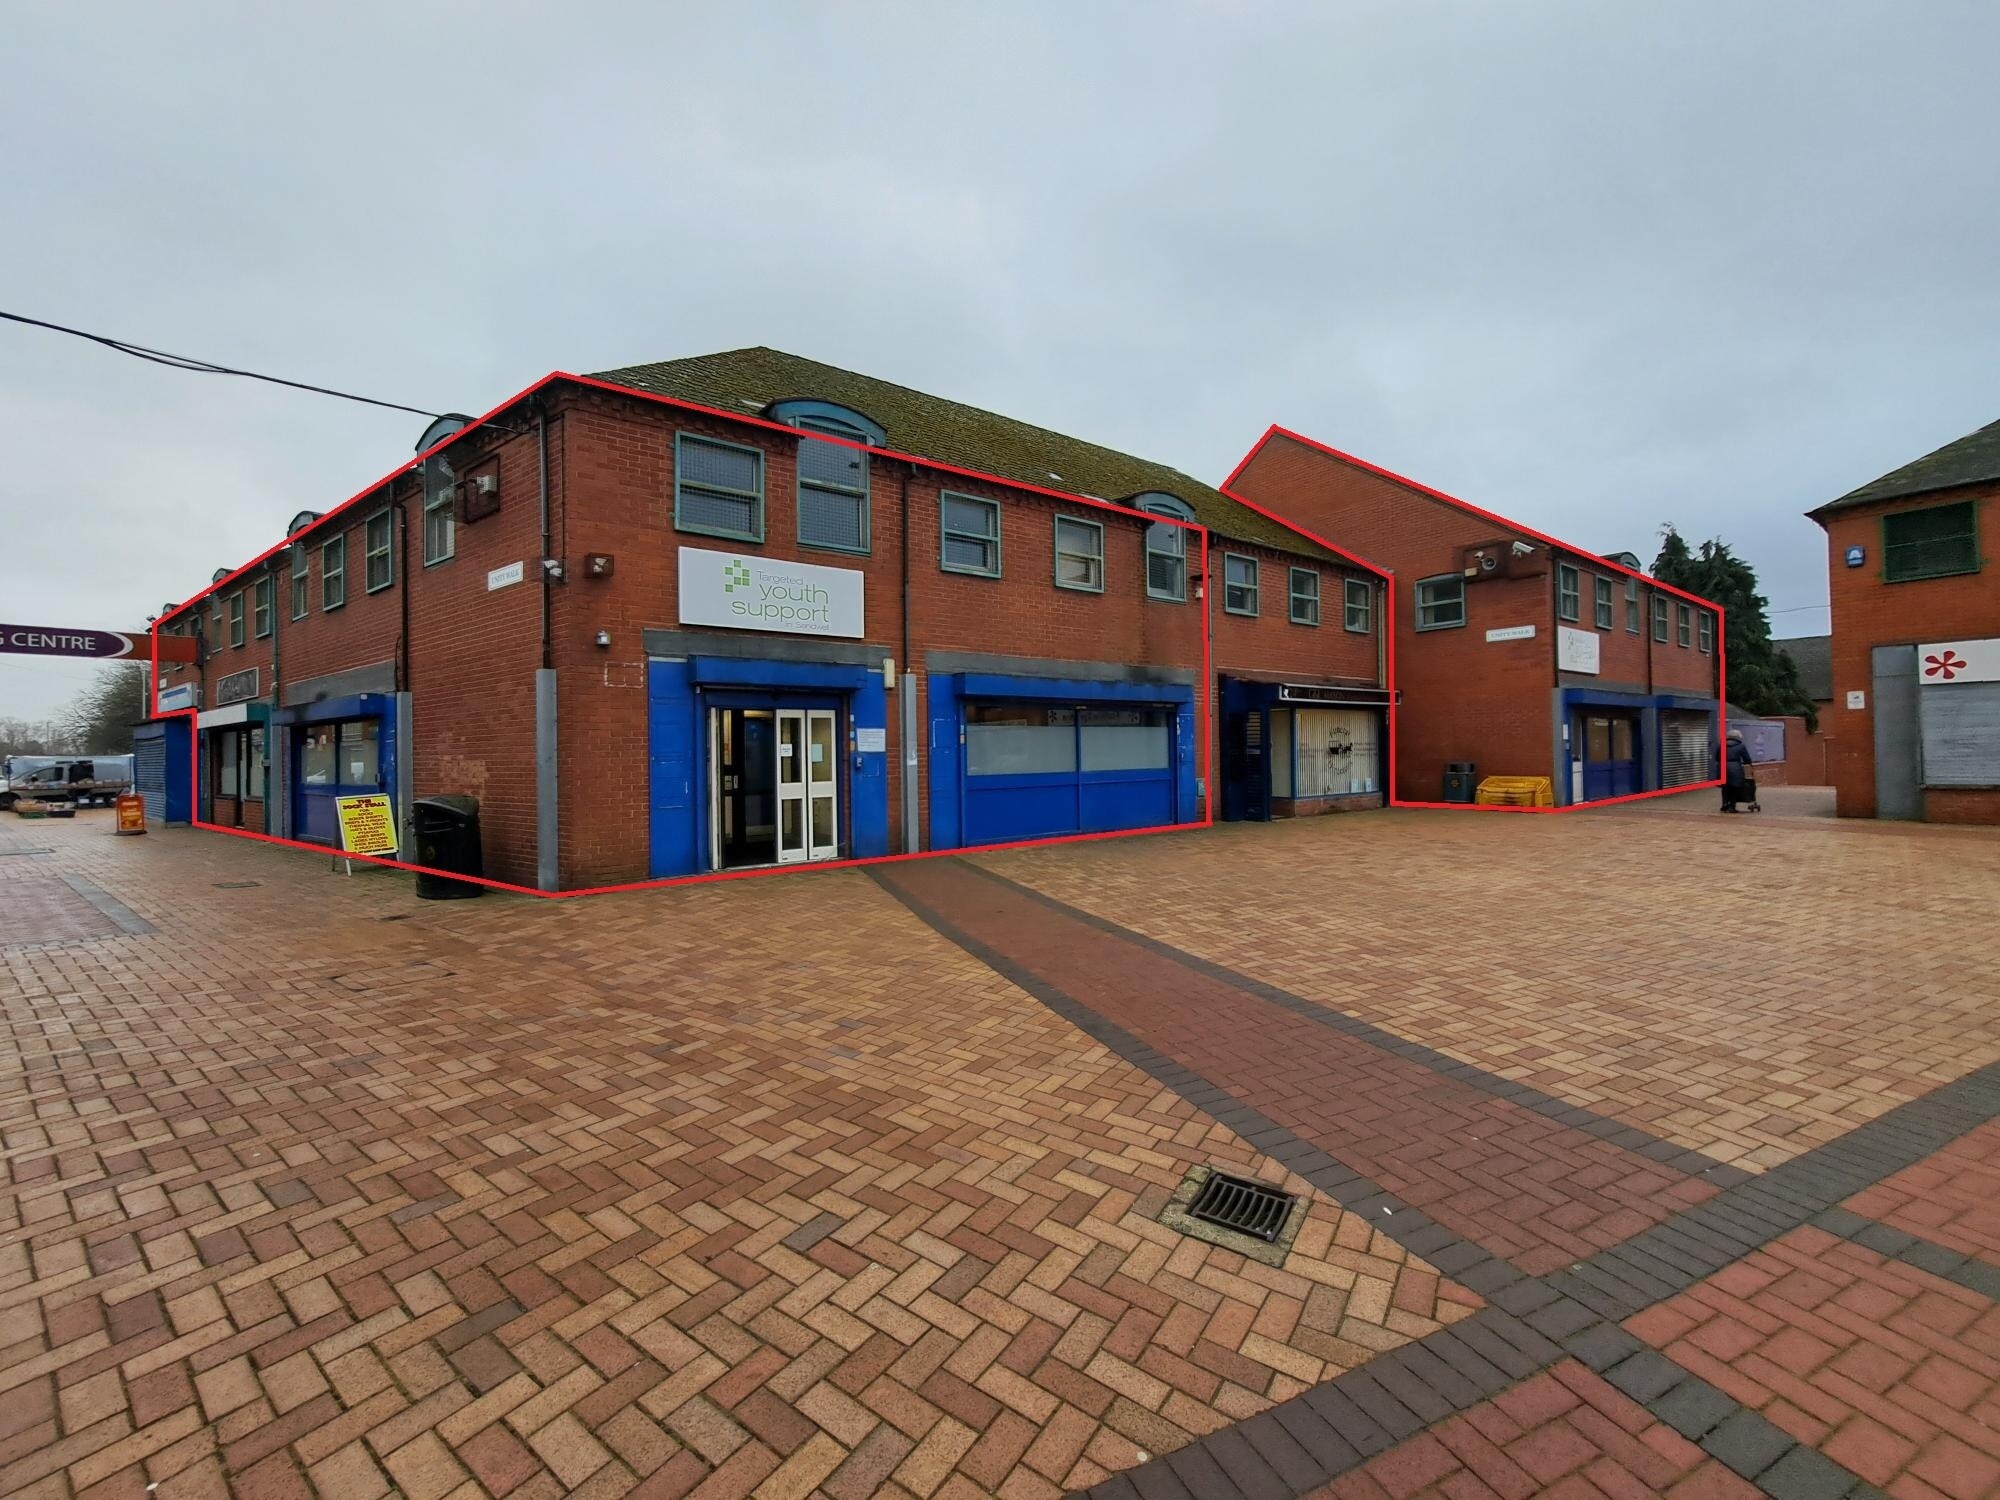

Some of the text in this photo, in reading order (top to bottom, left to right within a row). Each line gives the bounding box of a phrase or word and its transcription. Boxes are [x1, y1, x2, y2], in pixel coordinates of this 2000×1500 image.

[756, 571, 804, 585] Targeted
[759, 583, 829, 604] youth
[731, 600, 829, 623] support
[11, 632, 96, 650] CENTRE
